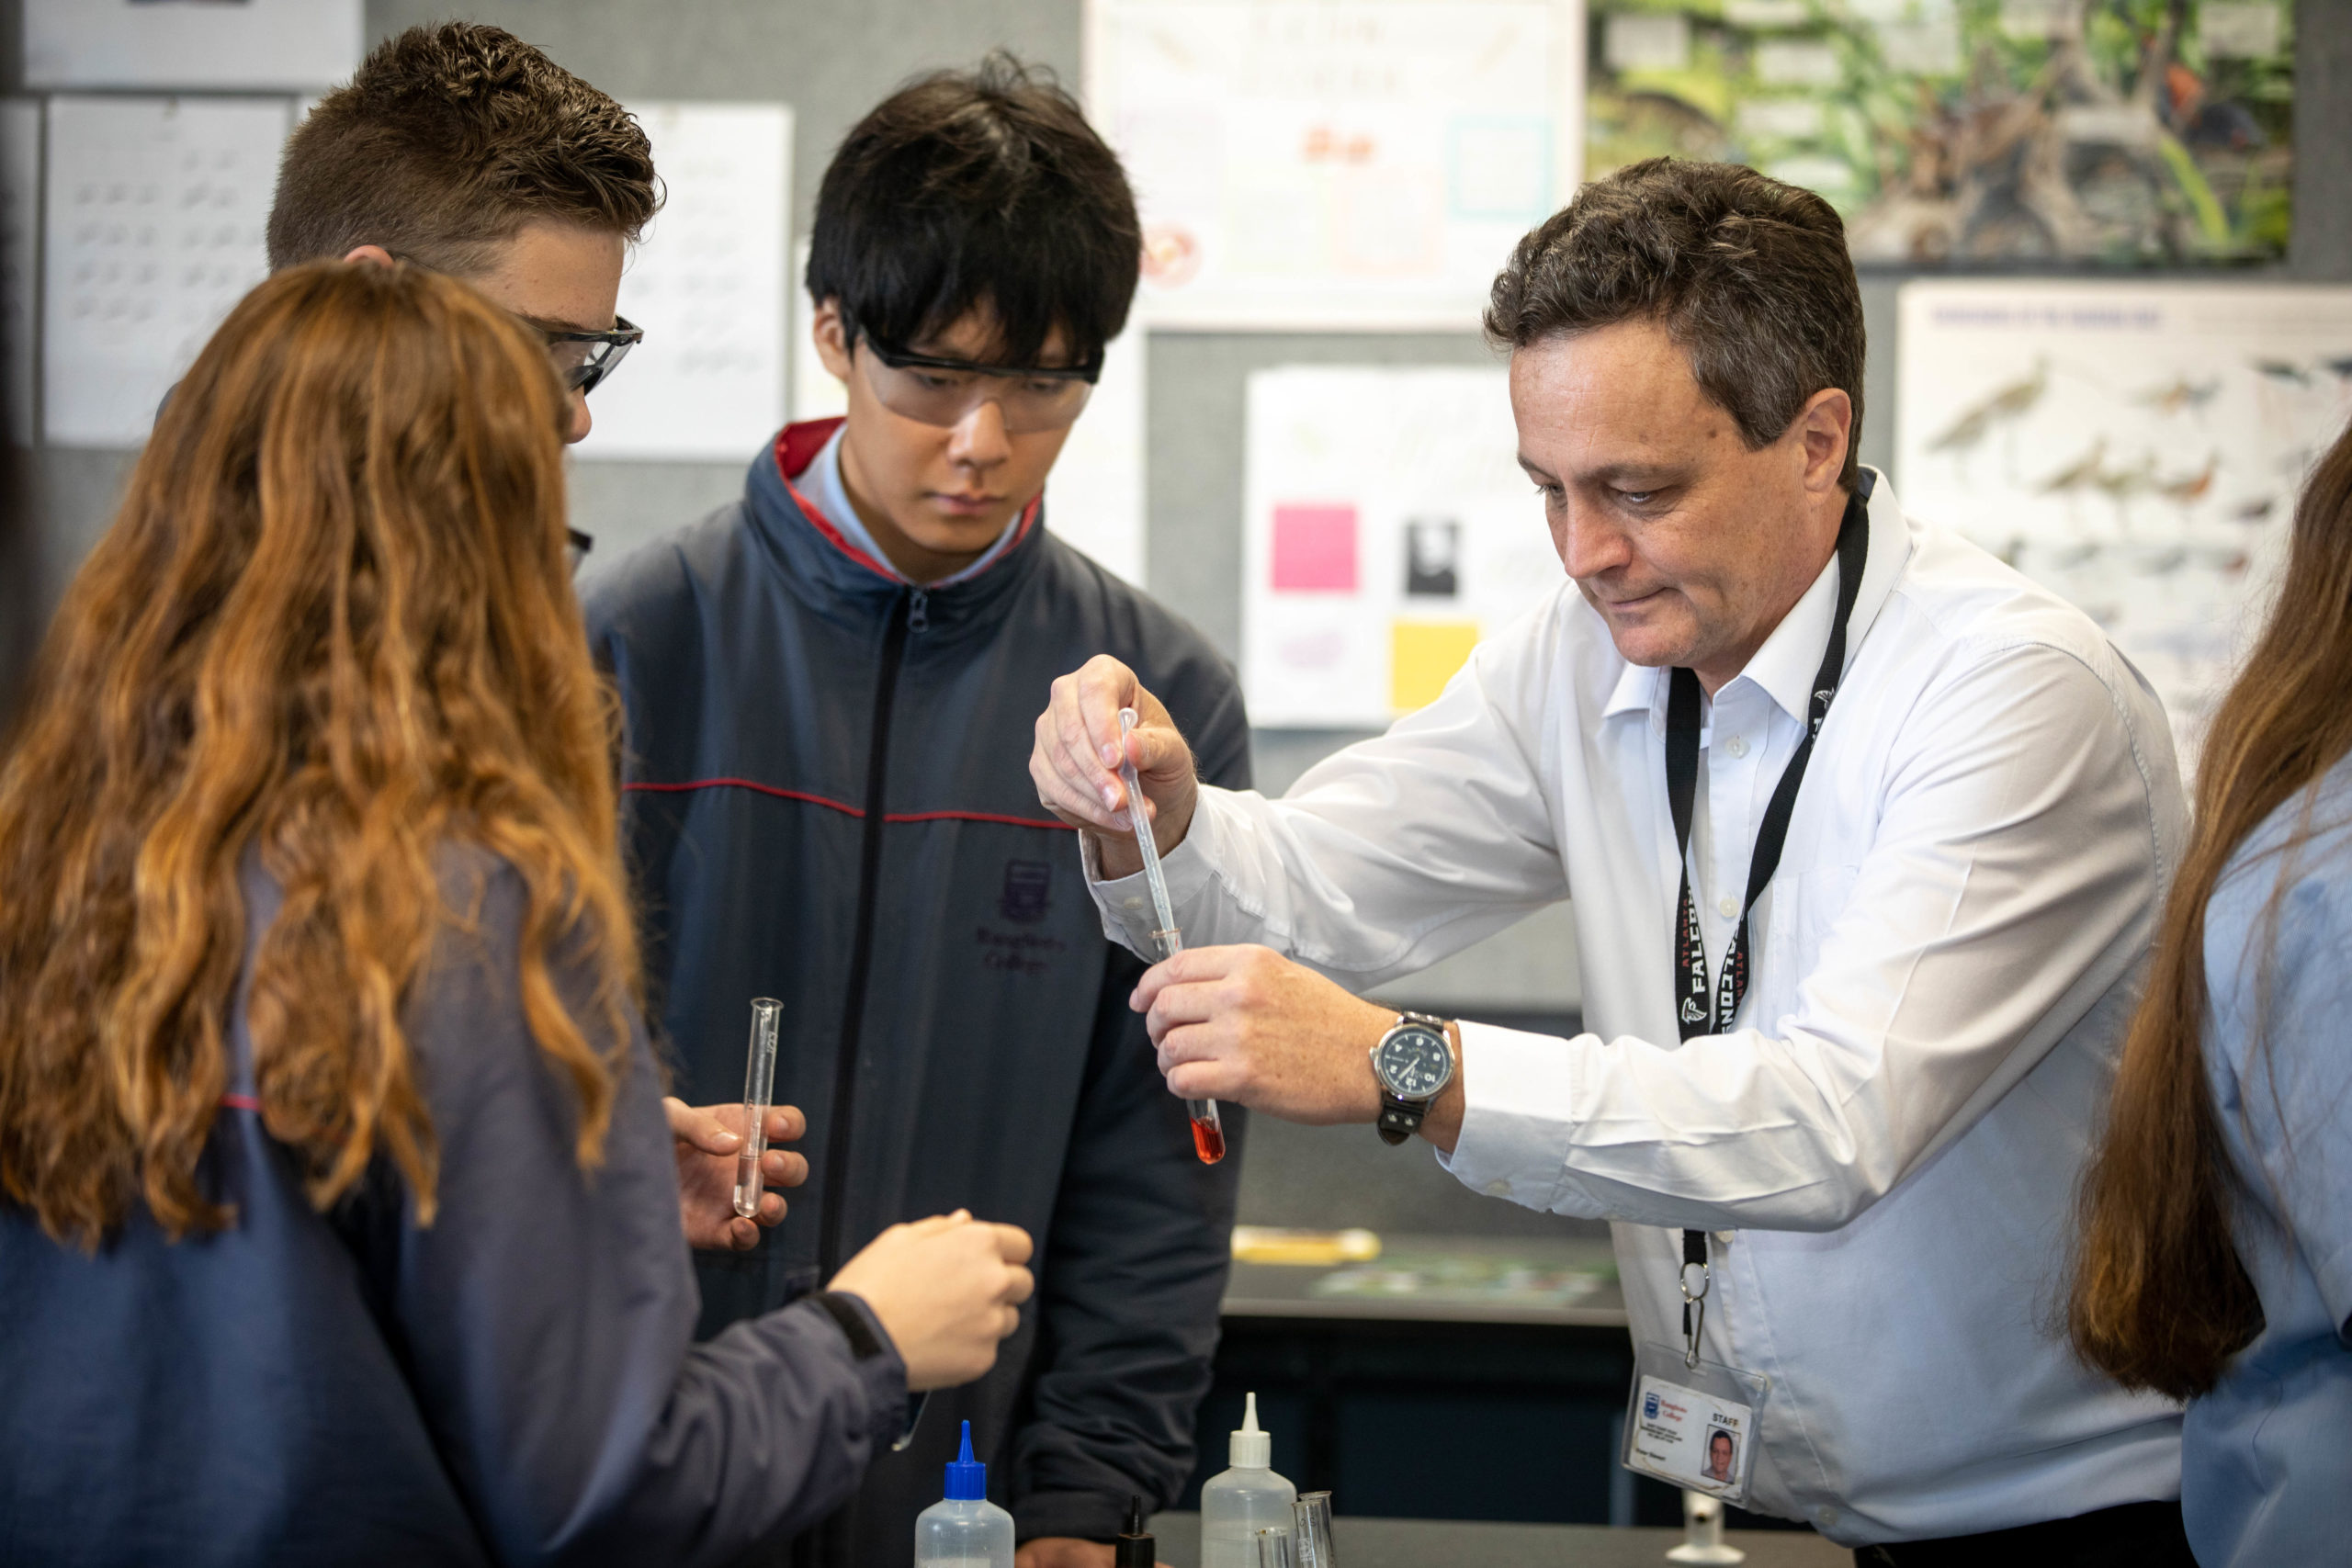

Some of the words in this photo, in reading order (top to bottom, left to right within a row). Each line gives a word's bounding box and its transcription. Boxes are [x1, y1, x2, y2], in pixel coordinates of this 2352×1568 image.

[1682, 897, 1690, 968] ATLANTA
[1688, 886, 1706, 994] FALCO
[1721, 930, 1738, 1034] ALCON
[1424, 1072, 1436, 1083] 10
[1712, 1413, 1739, 1426] STAFF
